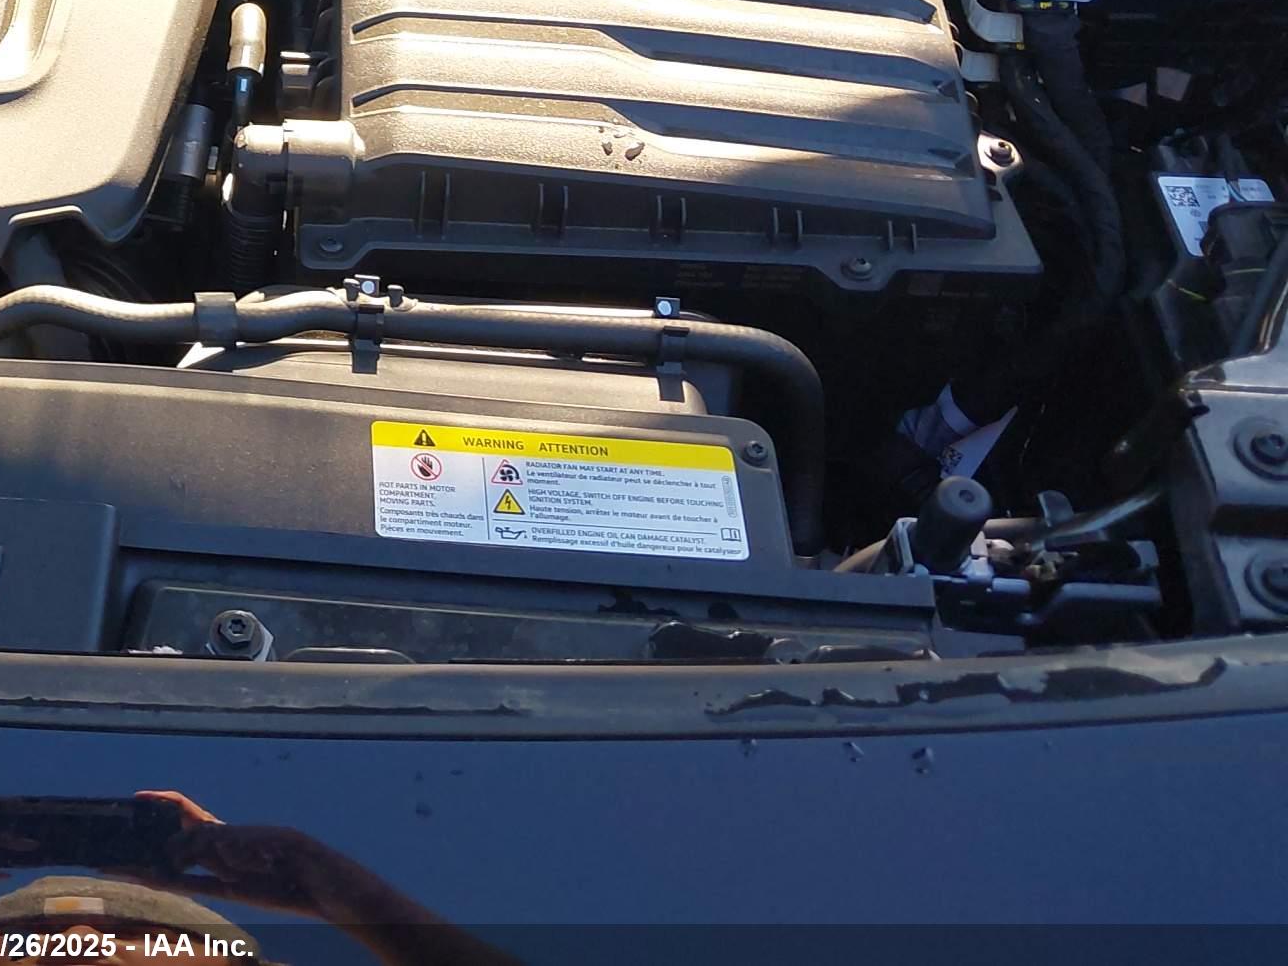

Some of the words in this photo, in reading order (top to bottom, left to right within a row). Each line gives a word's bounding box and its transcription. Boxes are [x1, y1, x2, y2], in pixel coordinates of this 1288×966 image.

[462, 436, 525, 450] WARNING
[539, 442, 608, 456] ATTENTION
[526, 461, 562, 470] RADIATOR
[563, 463, 578, 471] FAN
[579, 464, 595, 472] MAY
[596, 465, 618, 473] START
[629, 467, 646, 475] ANY
[379, 481, 394, 489] HOT
[396, 482, 418, 490] PARTS
[429, 485, 456, 493] MOTOR
[537, 471, 577, 480] ventilateur
[578, 473, 587, 481] de
[589, 473, 623, 482] radiateur
[624, 476, 641, 485] peut
[652, 478, 692, 488] déclencher
[700, 481, 716, 489] tout
[379, 497, 409, 505] MOVING
[528, 488, 547, 496] HIGH
[583, 492, 612, 500] SWITCH
[627, 495, 655, 503] ENGINE
[656, 497, 685, 505] BEFORE
[686, 499, 725, 508] TOUCHING
[529, 495, 562, 504] IGNITION
[380, 507, 423, 517] Composants
[425, 509, 439, 518] très
[440, 511, 466, 520] chauds
[467, 513, 484, 521] dans
[380, 515, 387, 523] le
[388, 517, 442, 527] compartiment
[620, 511, 648, 519] moteur
[683, 515, 712, 523] toucher
[380, 523, 404, 532] Pièces
[531, 526, 576, 536] OVERFILLED
[578, 529, 605, 538] ENGINE
[607, 531, 619, 539] OIL
[637, 533, 669, 542] DAMAGE
[532, 535, 578, 545] Remplissage
[579, 538, 608, 547] excessif
[611, 539, 635, 548] d'huile
[636, 541, 675, 551] dangereux
[677, 544, 694, 553] pour
